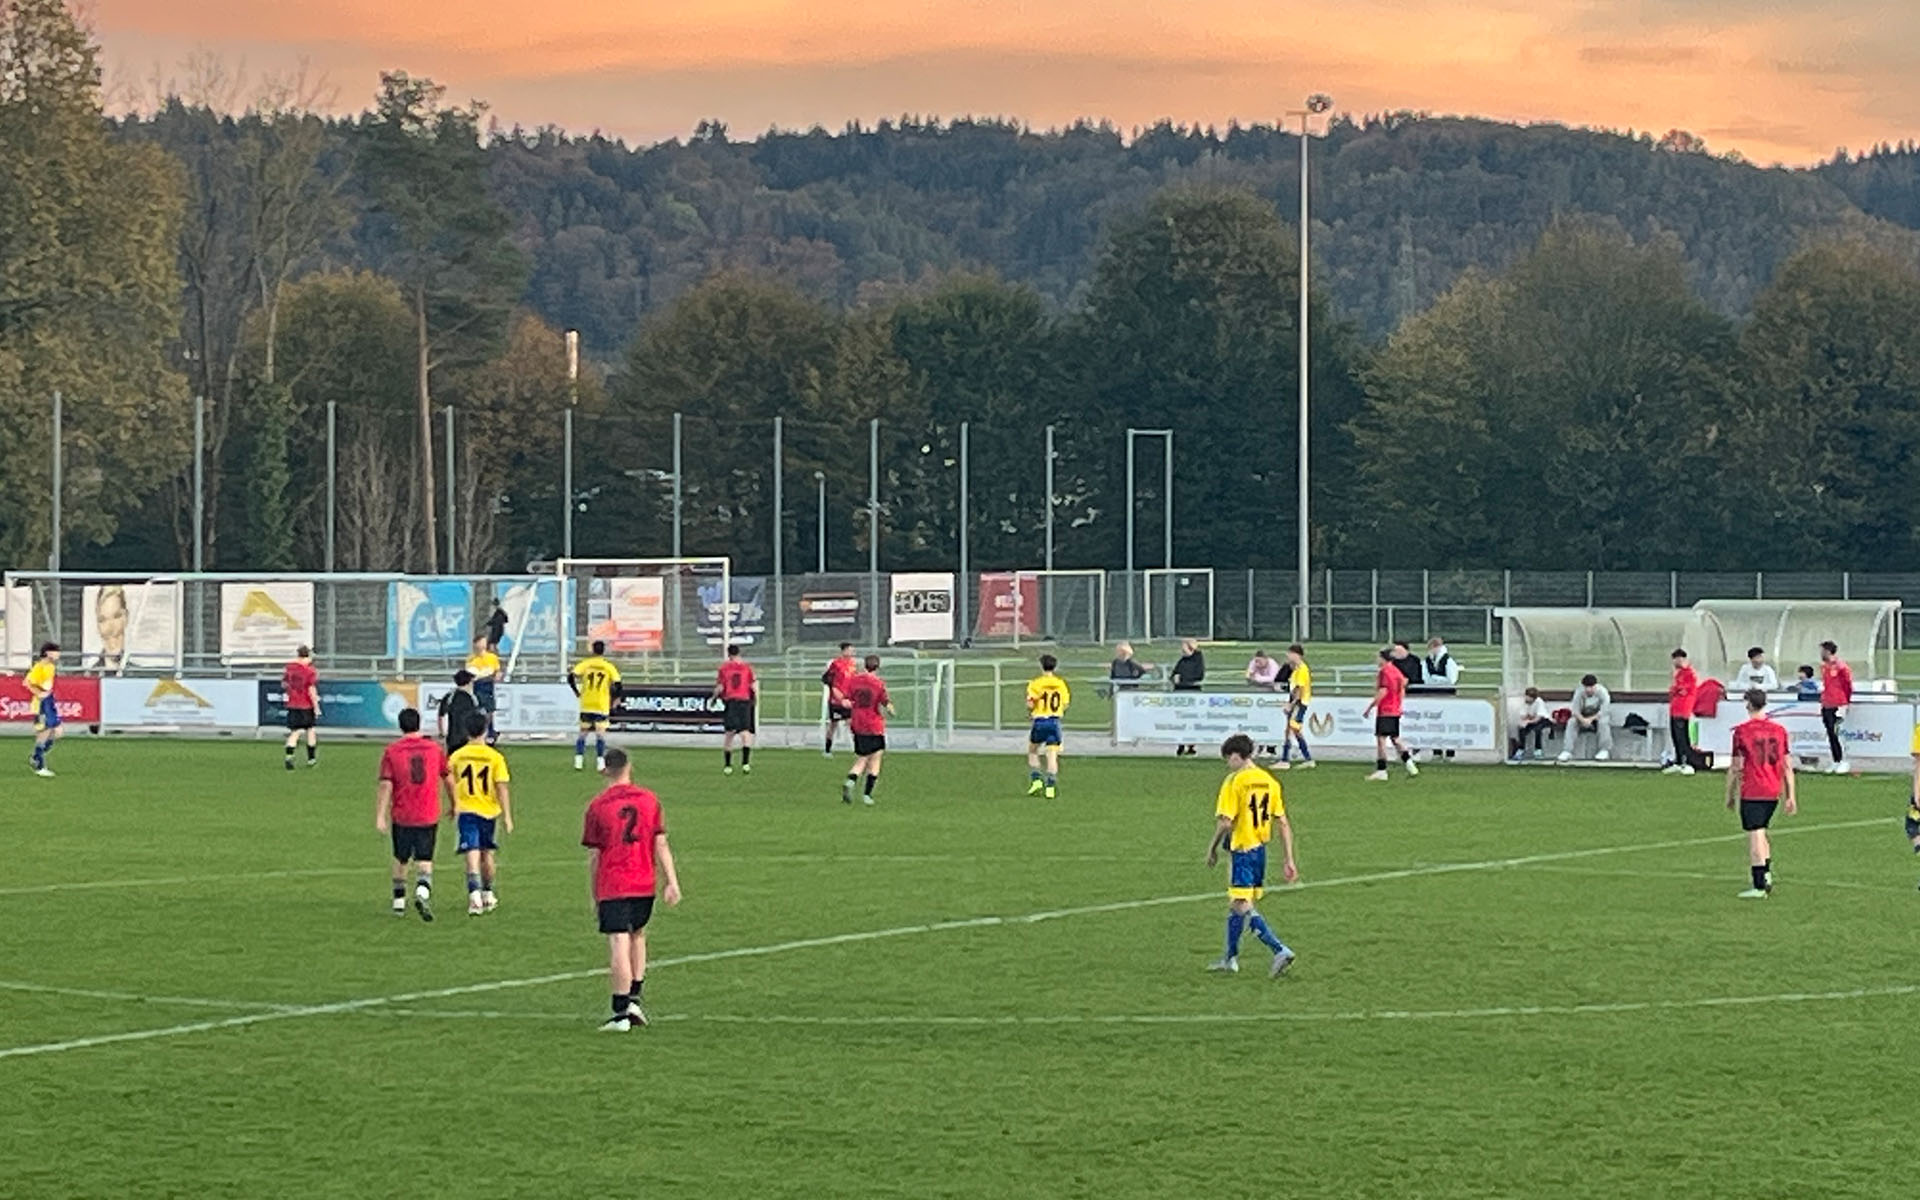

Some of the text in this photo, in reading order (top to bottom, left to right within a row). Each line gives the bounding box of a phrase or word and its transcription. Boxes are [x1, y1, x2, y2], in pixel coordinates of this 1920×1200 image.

[0, 697, 83, 718] Spasse
[1039, 690, 1061, 712] 10
[461, 763, 489, 796] 11
[617, 804, 640, 844] 2
